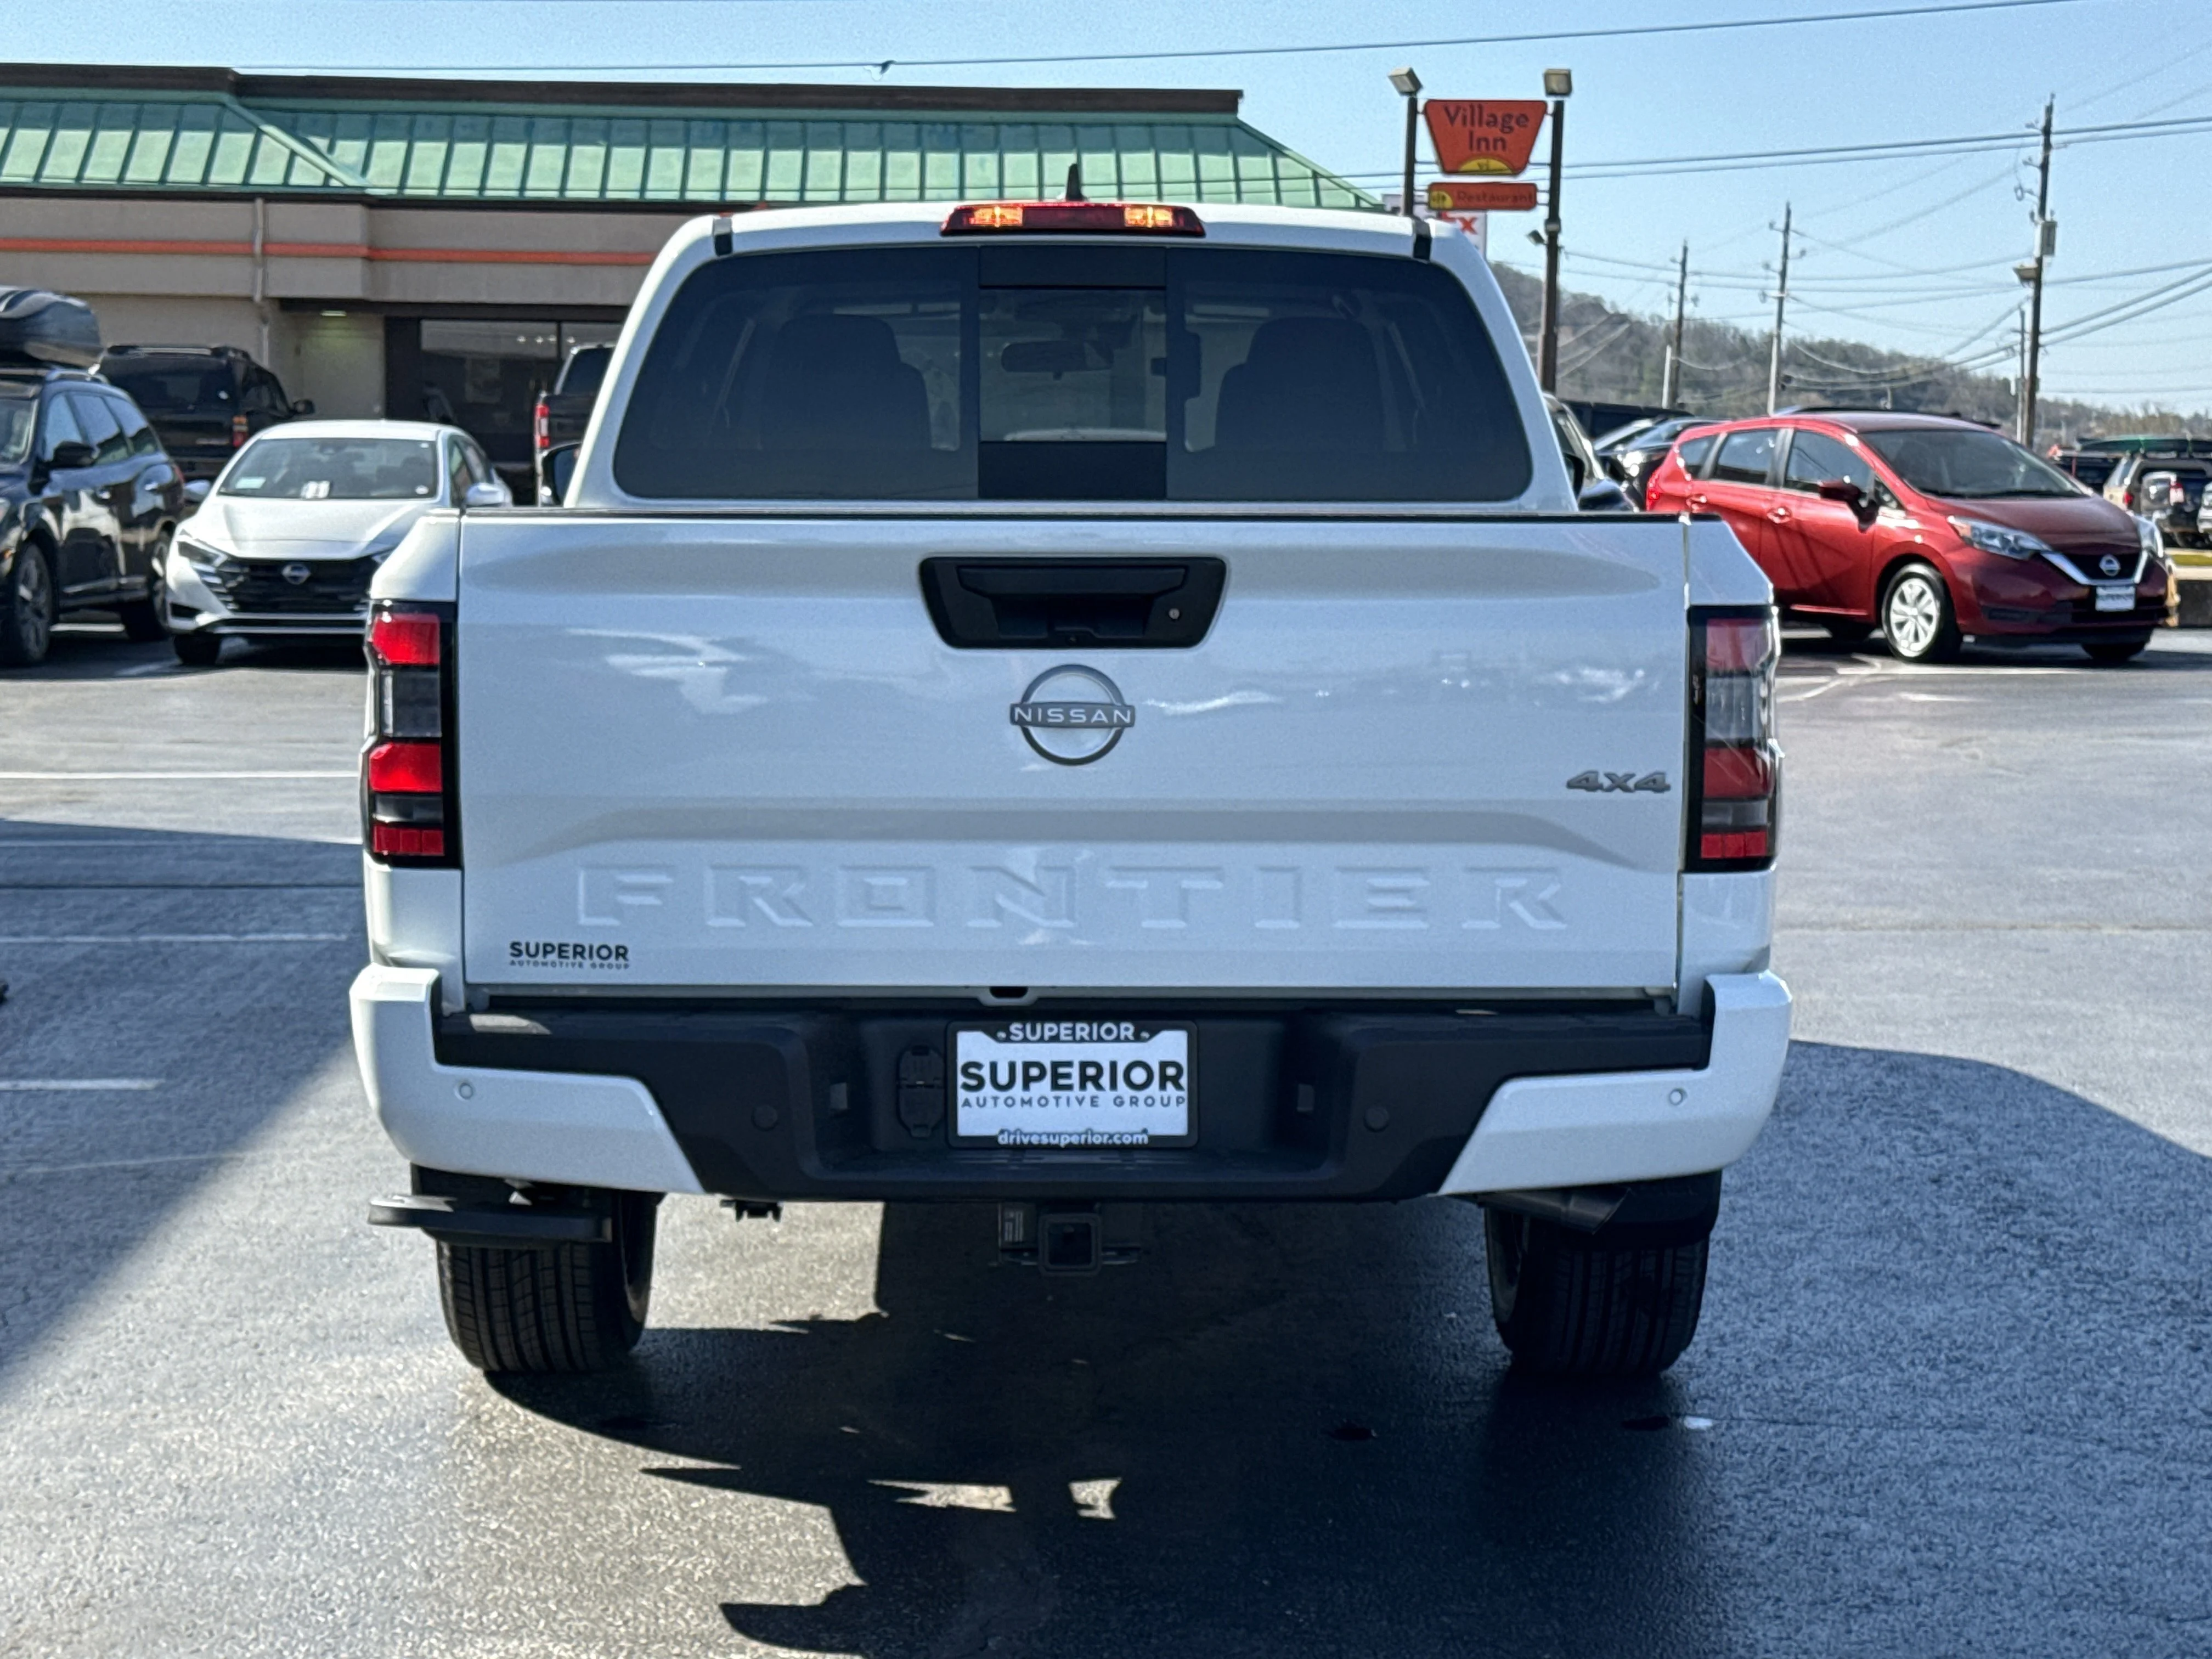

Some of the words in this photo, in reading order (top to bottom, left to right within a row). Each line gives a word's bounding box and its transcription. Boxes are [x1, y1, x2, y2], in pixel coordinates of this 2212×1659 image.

[1443, 103, 1530, 134] Village
[1469, 130, 1506, 151] Inn
[1457, 190, 1534, 204] Restaurant
[1014, 707, 1131, 724] NISSAN
[578, 865, 1567, 928] FRONTIER
[509, 941, 629, 961] SUPERIOR
[509, 960, 584, 969] AUTOMOTIVE
[1008, 1022, 1135, 1041] SUPERIOR
[960, 1060, 1186, 1093] SUPERIOR
[961, 1095, 1100, 1108] AUTOMOTIVE
[1113, 1095, 1186, 1108] GROUP
[997, 1128, 1149, 1147] drivesuperior.com
